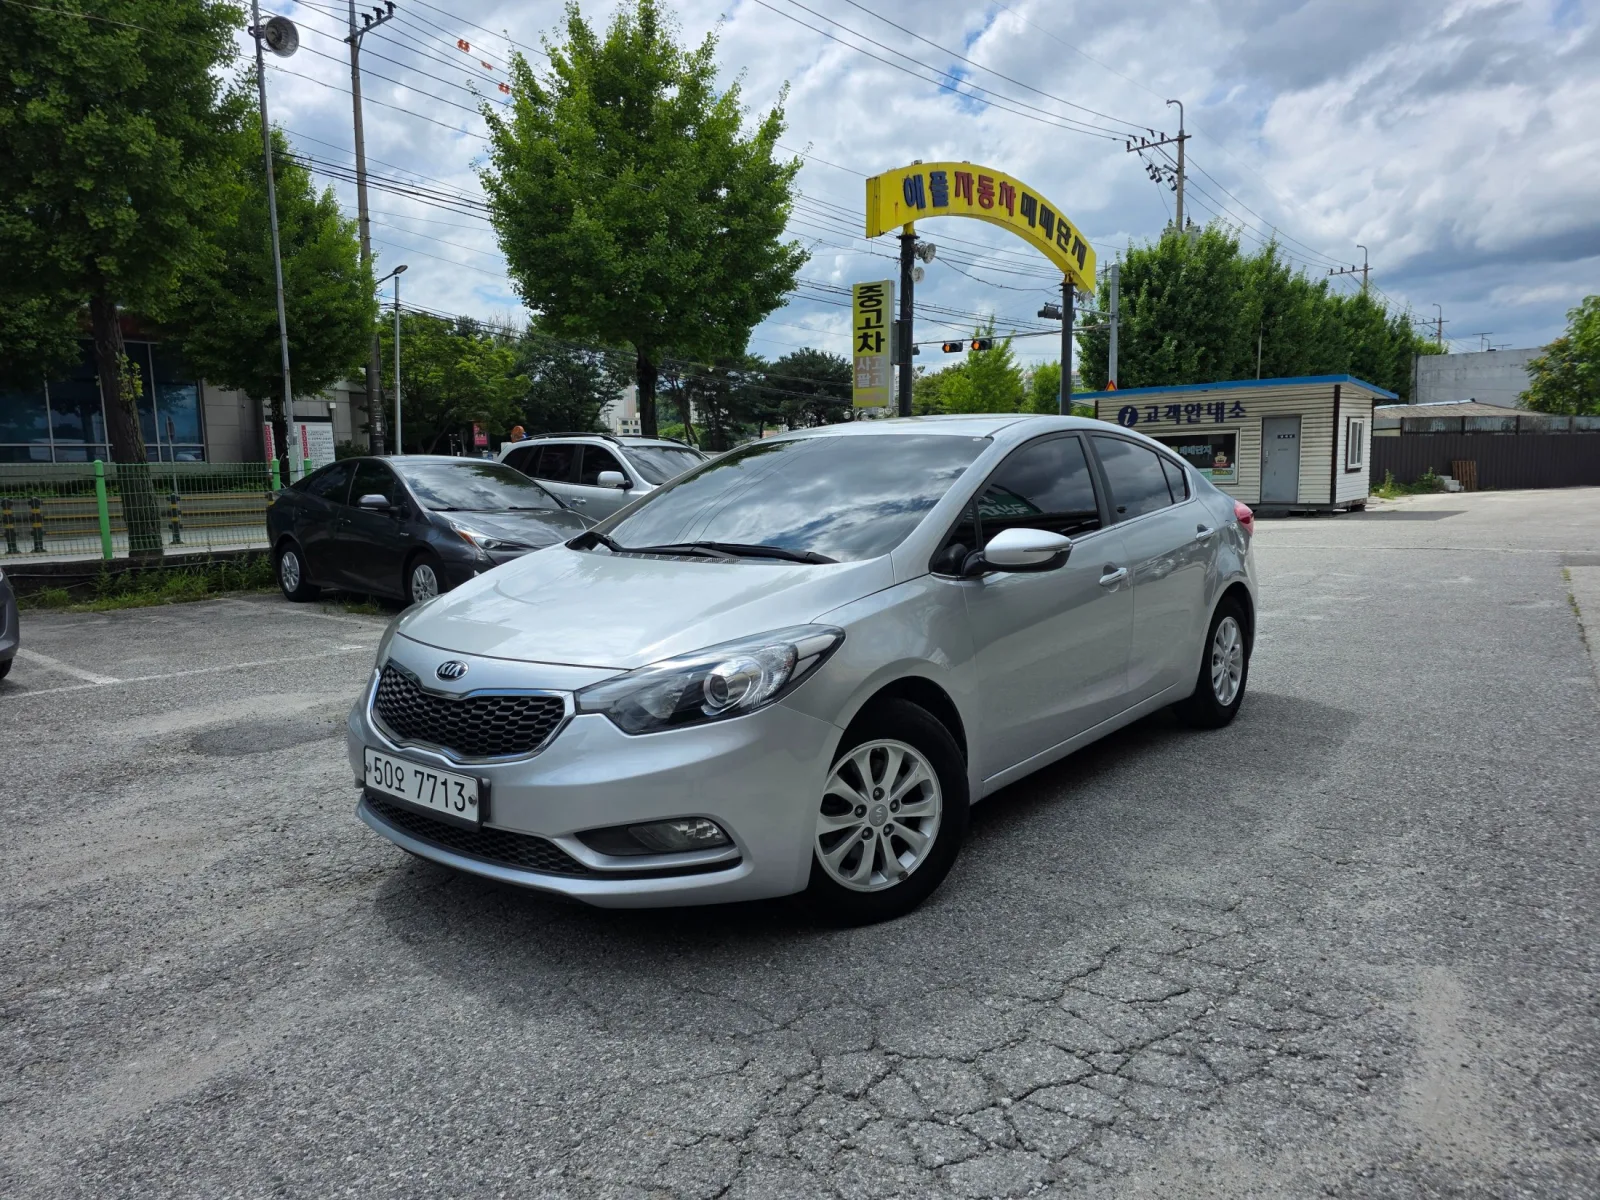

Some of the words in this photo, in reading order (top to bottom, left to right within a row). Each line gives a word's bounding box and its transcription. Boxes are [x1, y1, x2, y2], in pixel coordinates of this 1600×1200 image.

[857, 284, 886, 353] 중고차
[1143, 400, 1247, 425] 고객안내소
[438, 662, 461, 677] KIA
[374, 756, 406, 793] 50오
[414, 769, 466, 812] 7713
